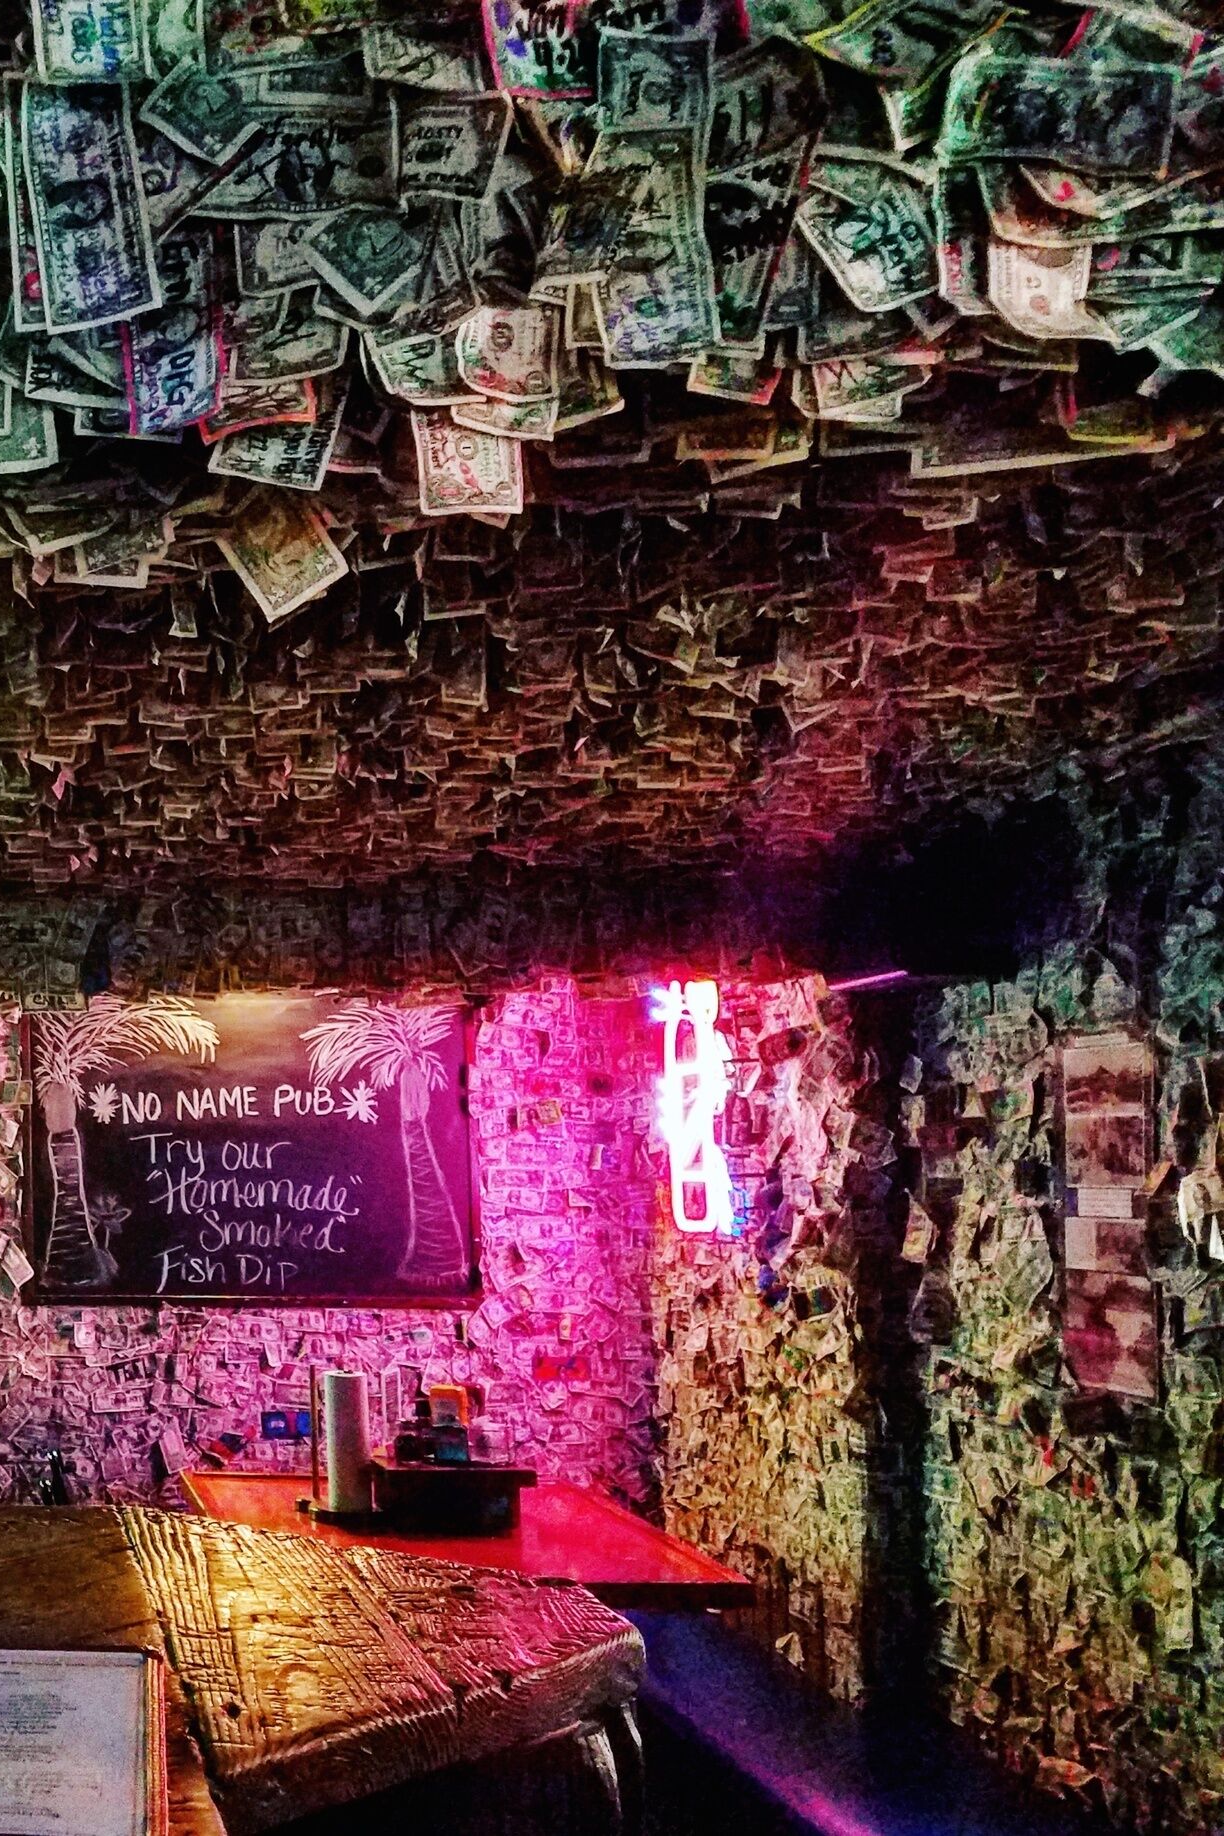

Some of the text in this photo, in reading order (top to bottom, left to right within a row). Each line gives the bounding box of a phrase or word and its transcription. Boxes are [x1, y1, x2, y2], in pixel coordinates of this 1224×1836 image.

[121, 1085, 336, 1124] NO NAME PUB
[129, 1132, 292, 1180] Try our
[155, 1245, 299, 1293] Fish Dip
